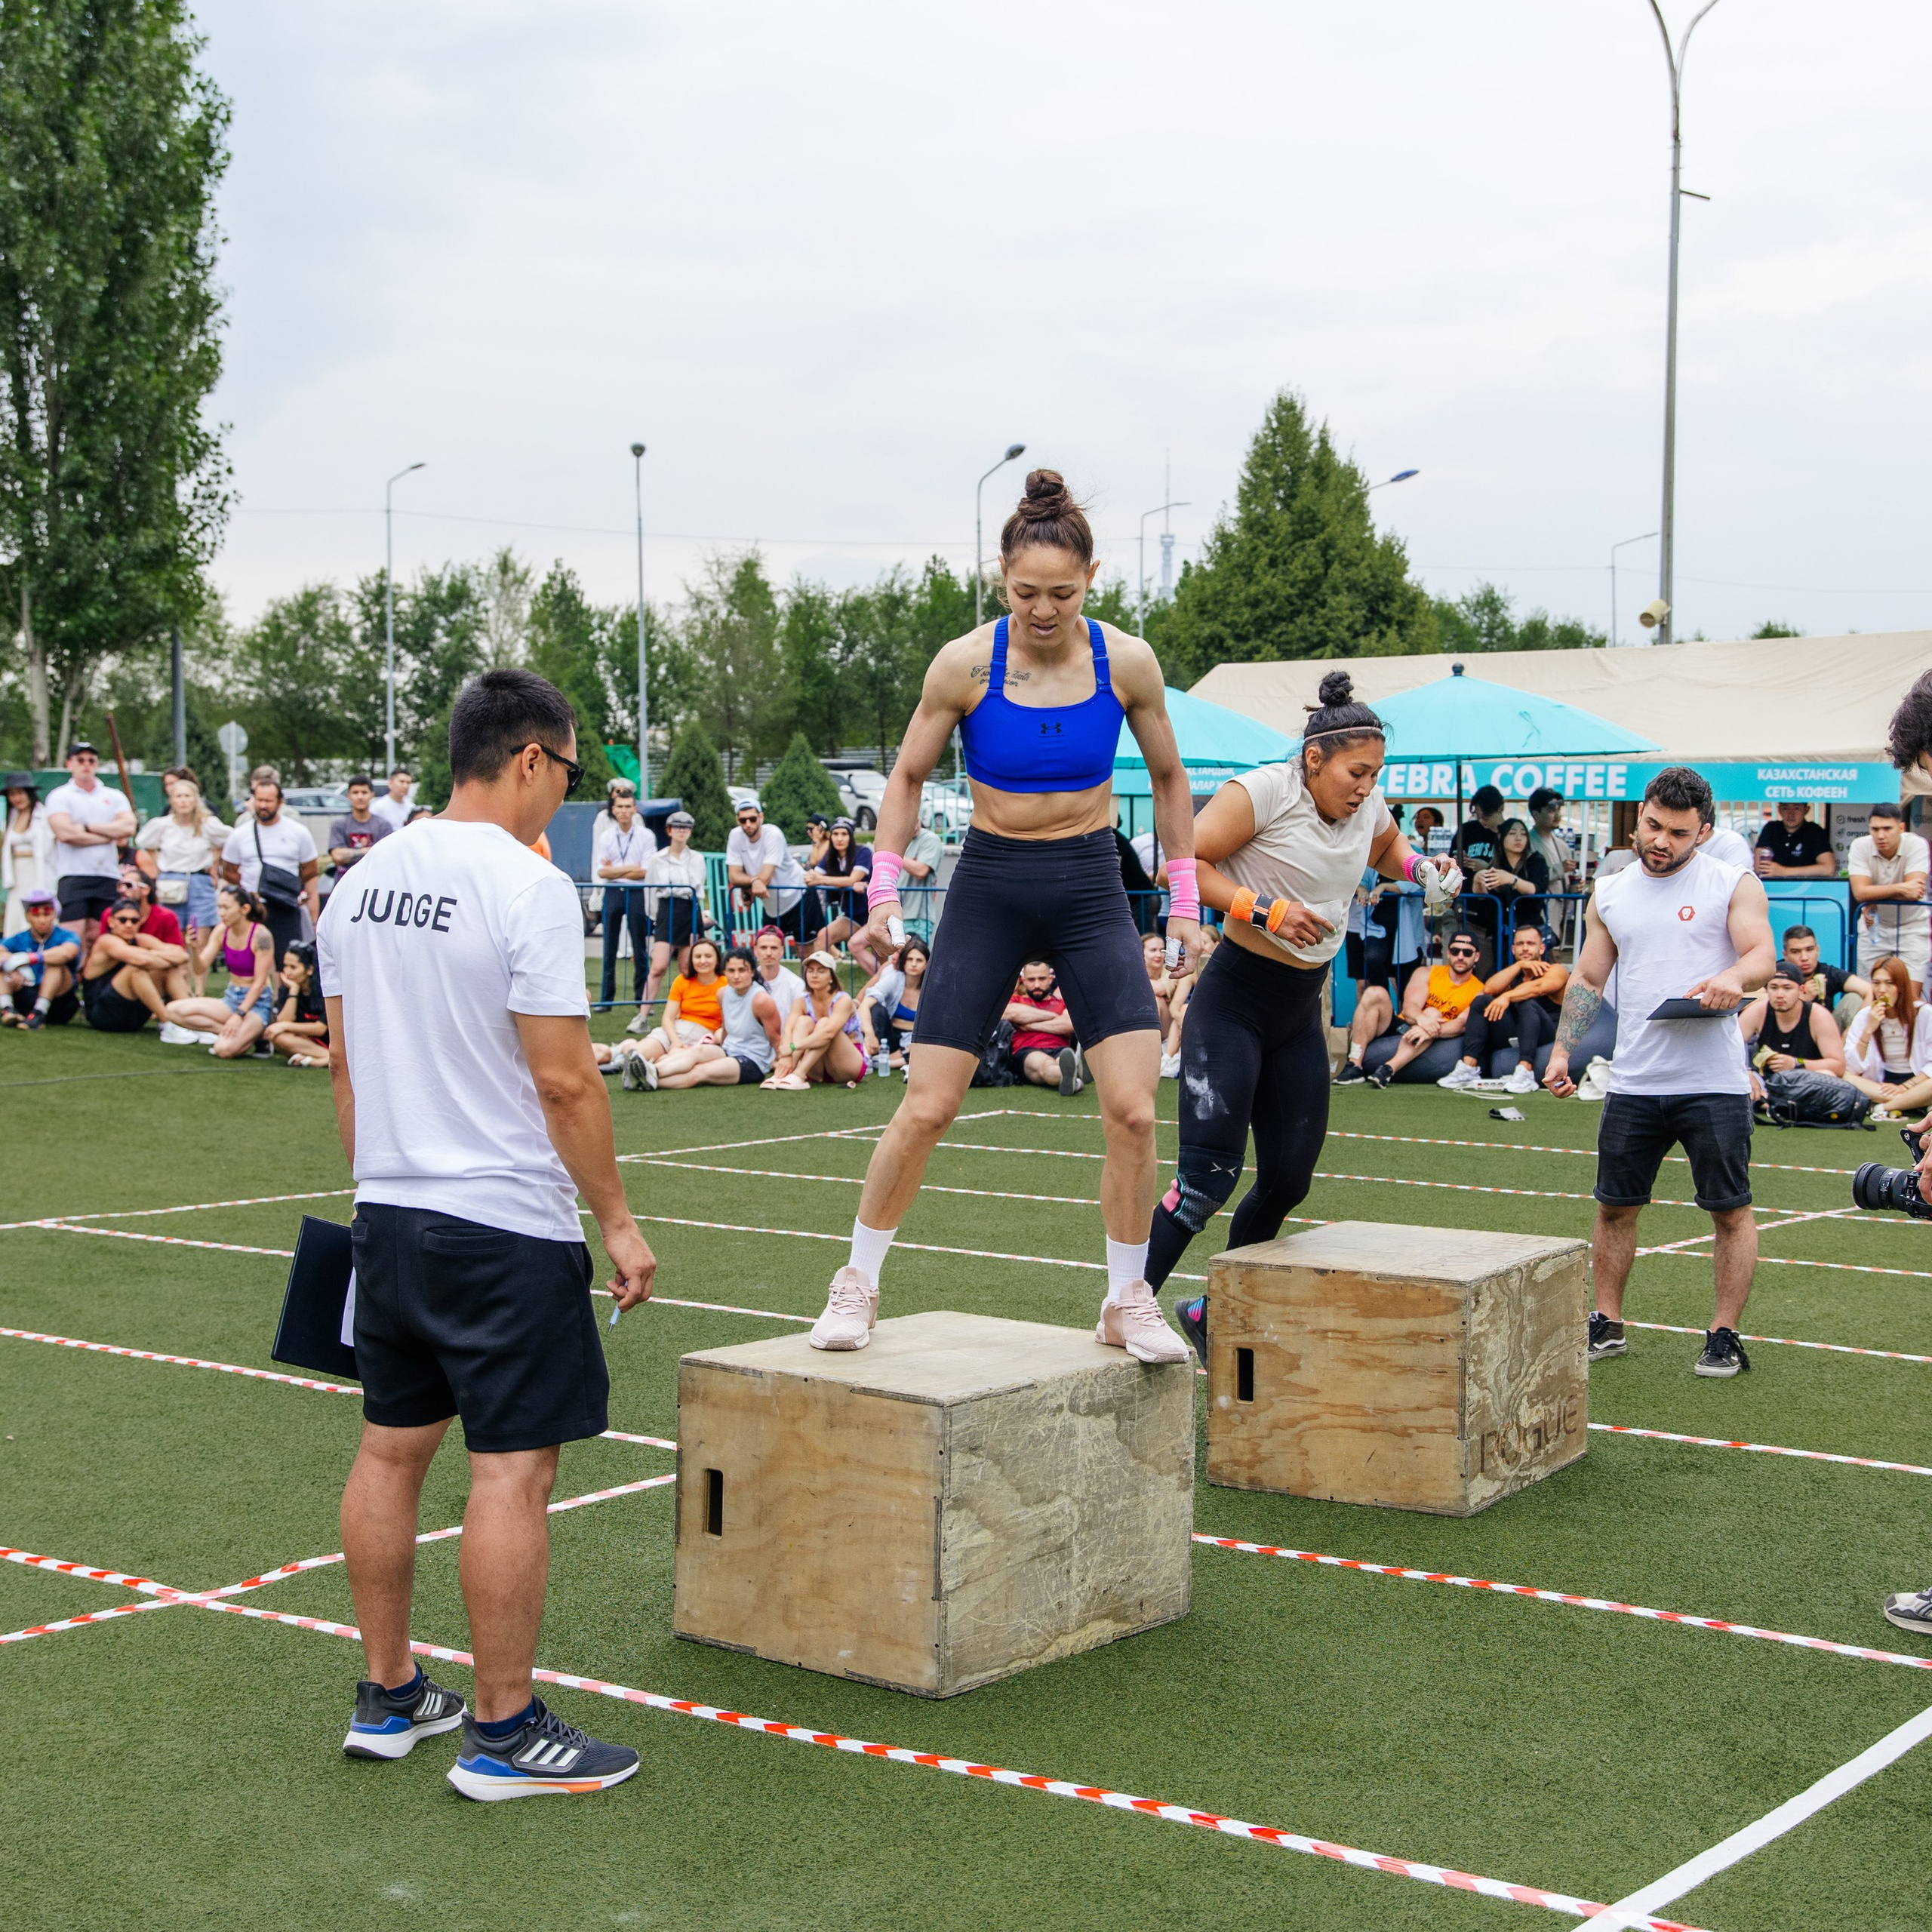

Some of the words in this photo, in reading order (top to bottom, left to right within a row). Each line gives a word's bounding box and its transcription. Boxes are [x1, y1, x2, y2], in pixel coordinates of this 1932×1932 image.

[1757, 768, 1858, 780] КАЗАХСТАНСКАЯ
[1491, 764, 1627, 797] COFFEE
[1764, 786, 1795, 798] СЕТЬ
[1796, 786, 1848, 798] КОФЕЕН
[1847, 815, 1866, 823] fresh
[350, 888, 457, 933] JUDGE
